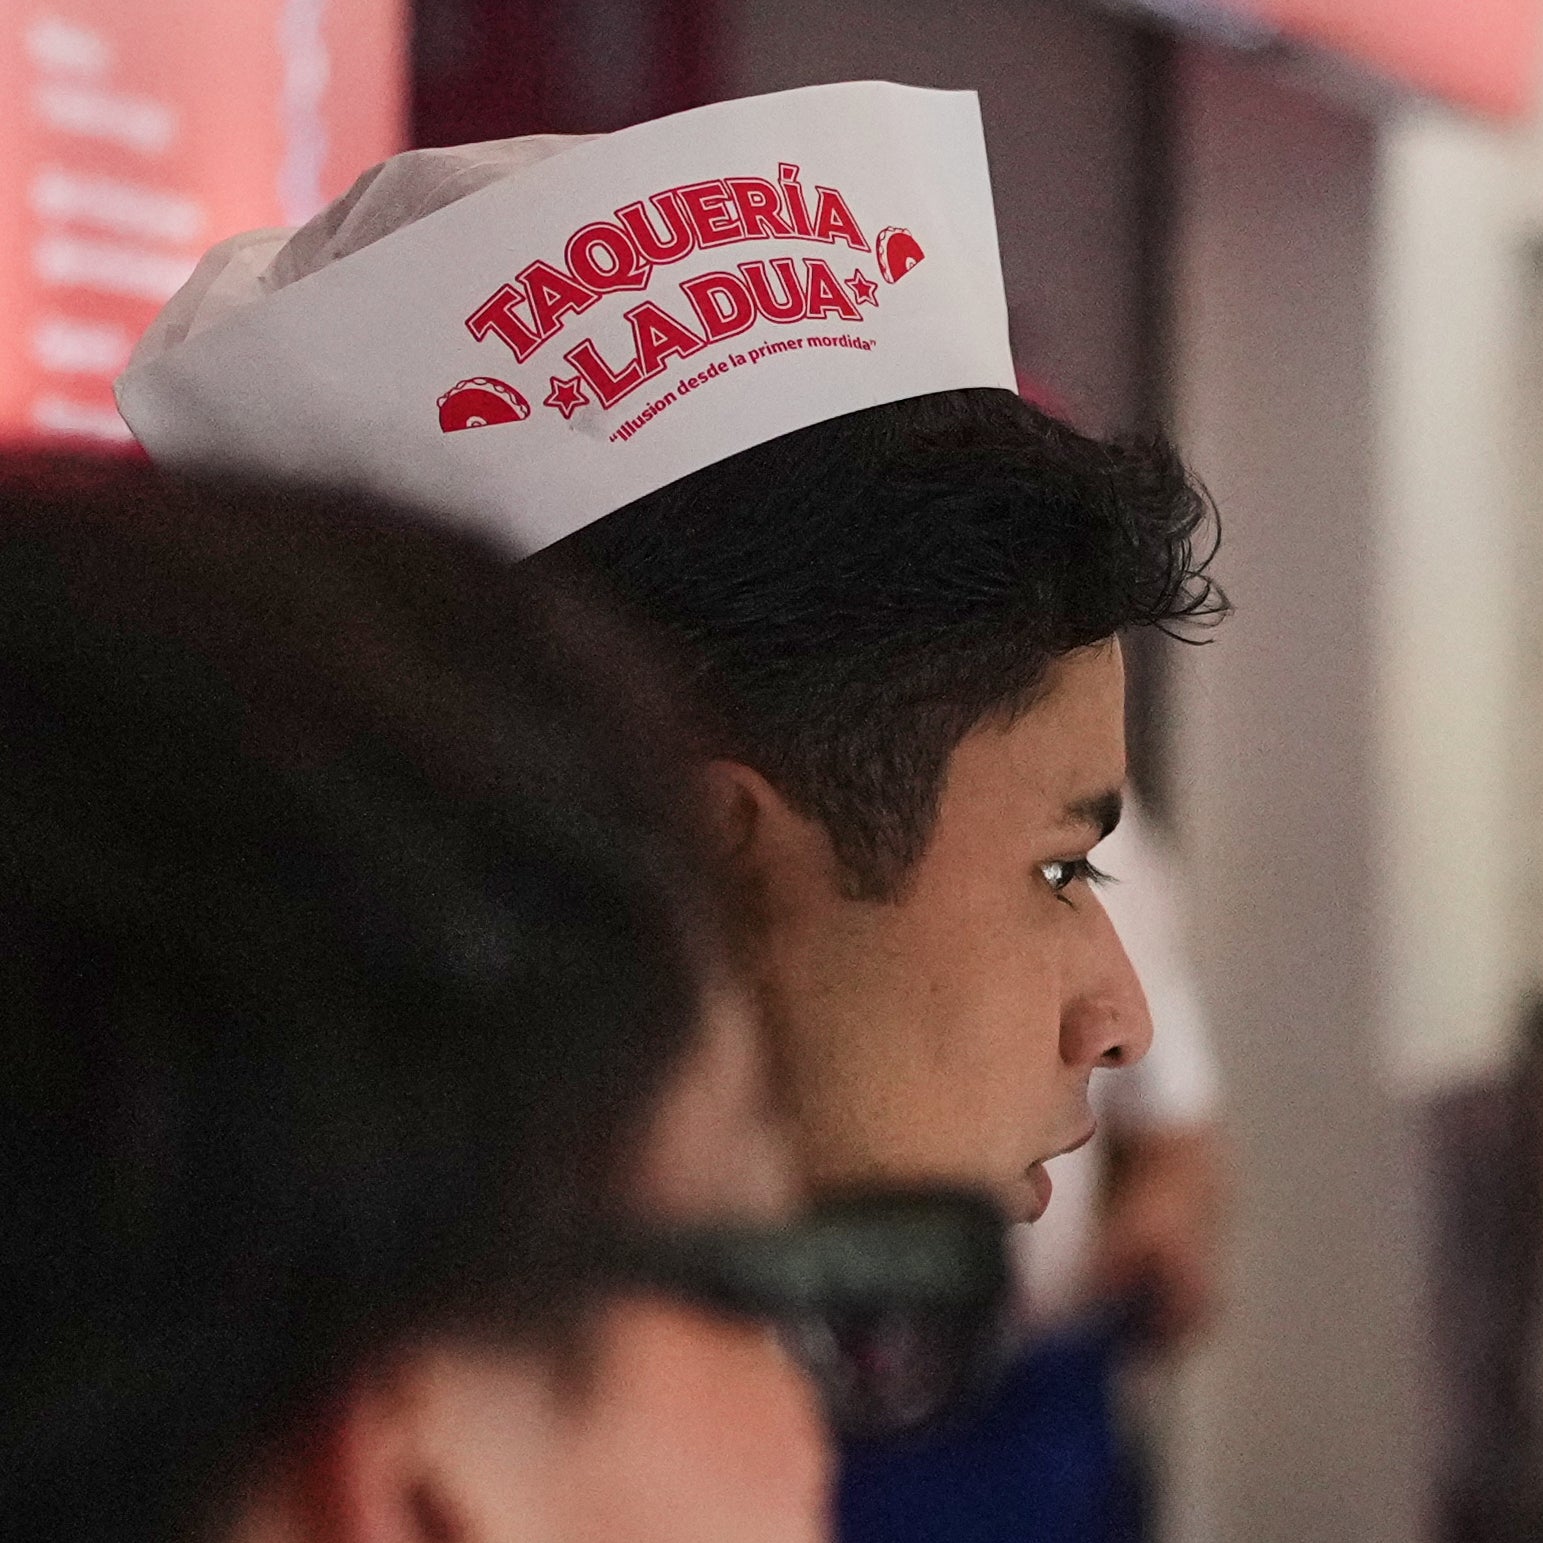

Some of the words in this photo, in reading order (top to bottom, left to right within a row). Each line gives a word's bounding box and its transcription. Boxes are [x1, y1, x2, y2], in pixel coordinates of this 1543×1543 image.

[465, 162, 871, 364] TAQUERÍA
[564, 301, 708, 410] LA
[680, 257, 864, 344] DUA
[676, 361, 730, 397] desde
[728, 353, 748, 369] la
[748, 335, 804, 365] primer
